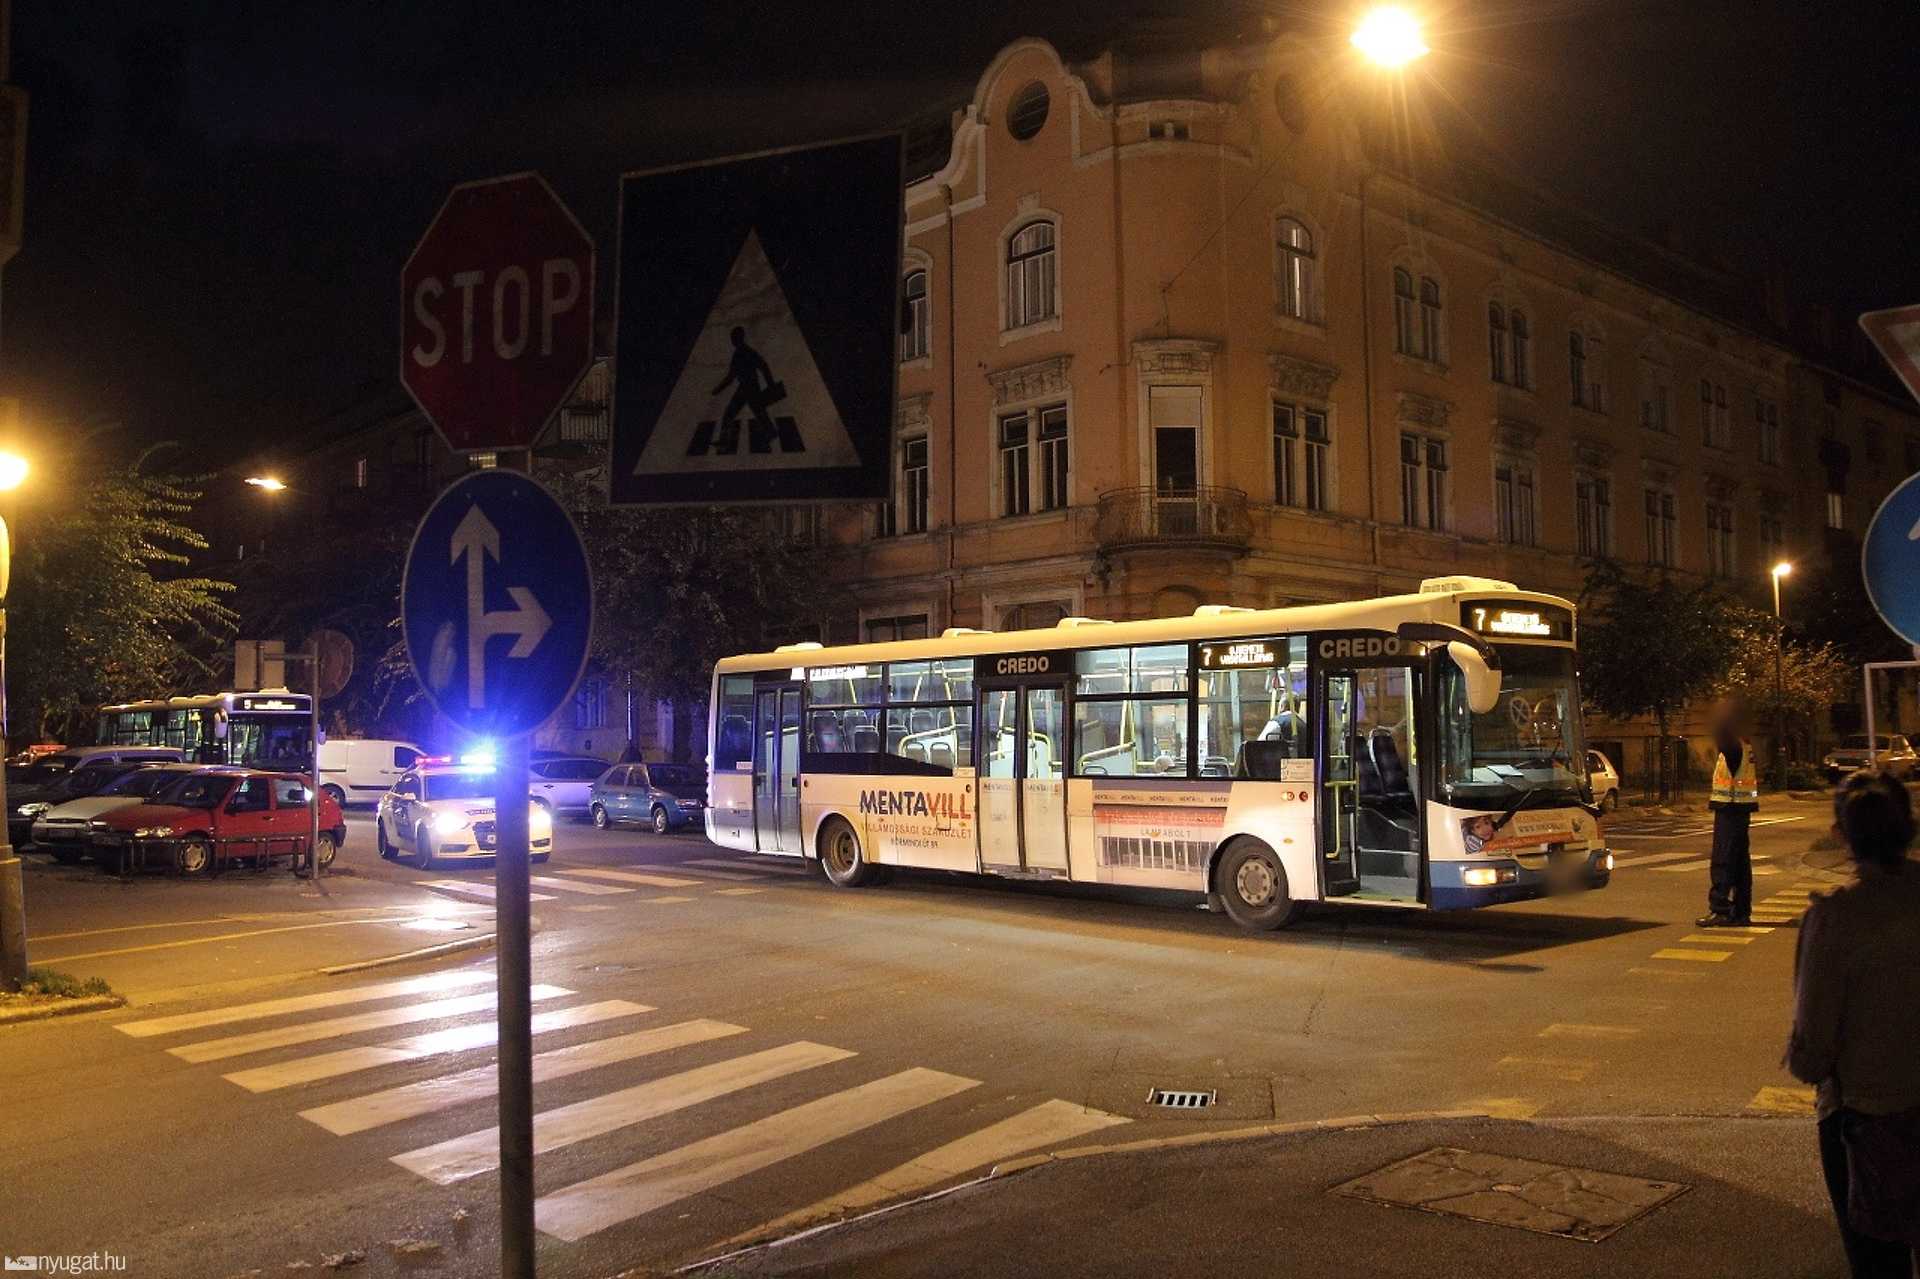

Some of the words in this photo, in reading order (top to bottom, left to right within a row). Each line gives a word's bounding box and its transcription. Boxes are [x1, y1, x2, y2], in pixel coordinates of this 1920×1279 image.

[411, 258, 581, 368] STOP
[1475, 608, 1486, 631] 7
[1202, 648, 1212, 667] 7
[1320, 637, 1401, 659] CREDO
[997, 656, 1049, 674] CREDO
[860, 789, 972, 820] MENTAVILL
